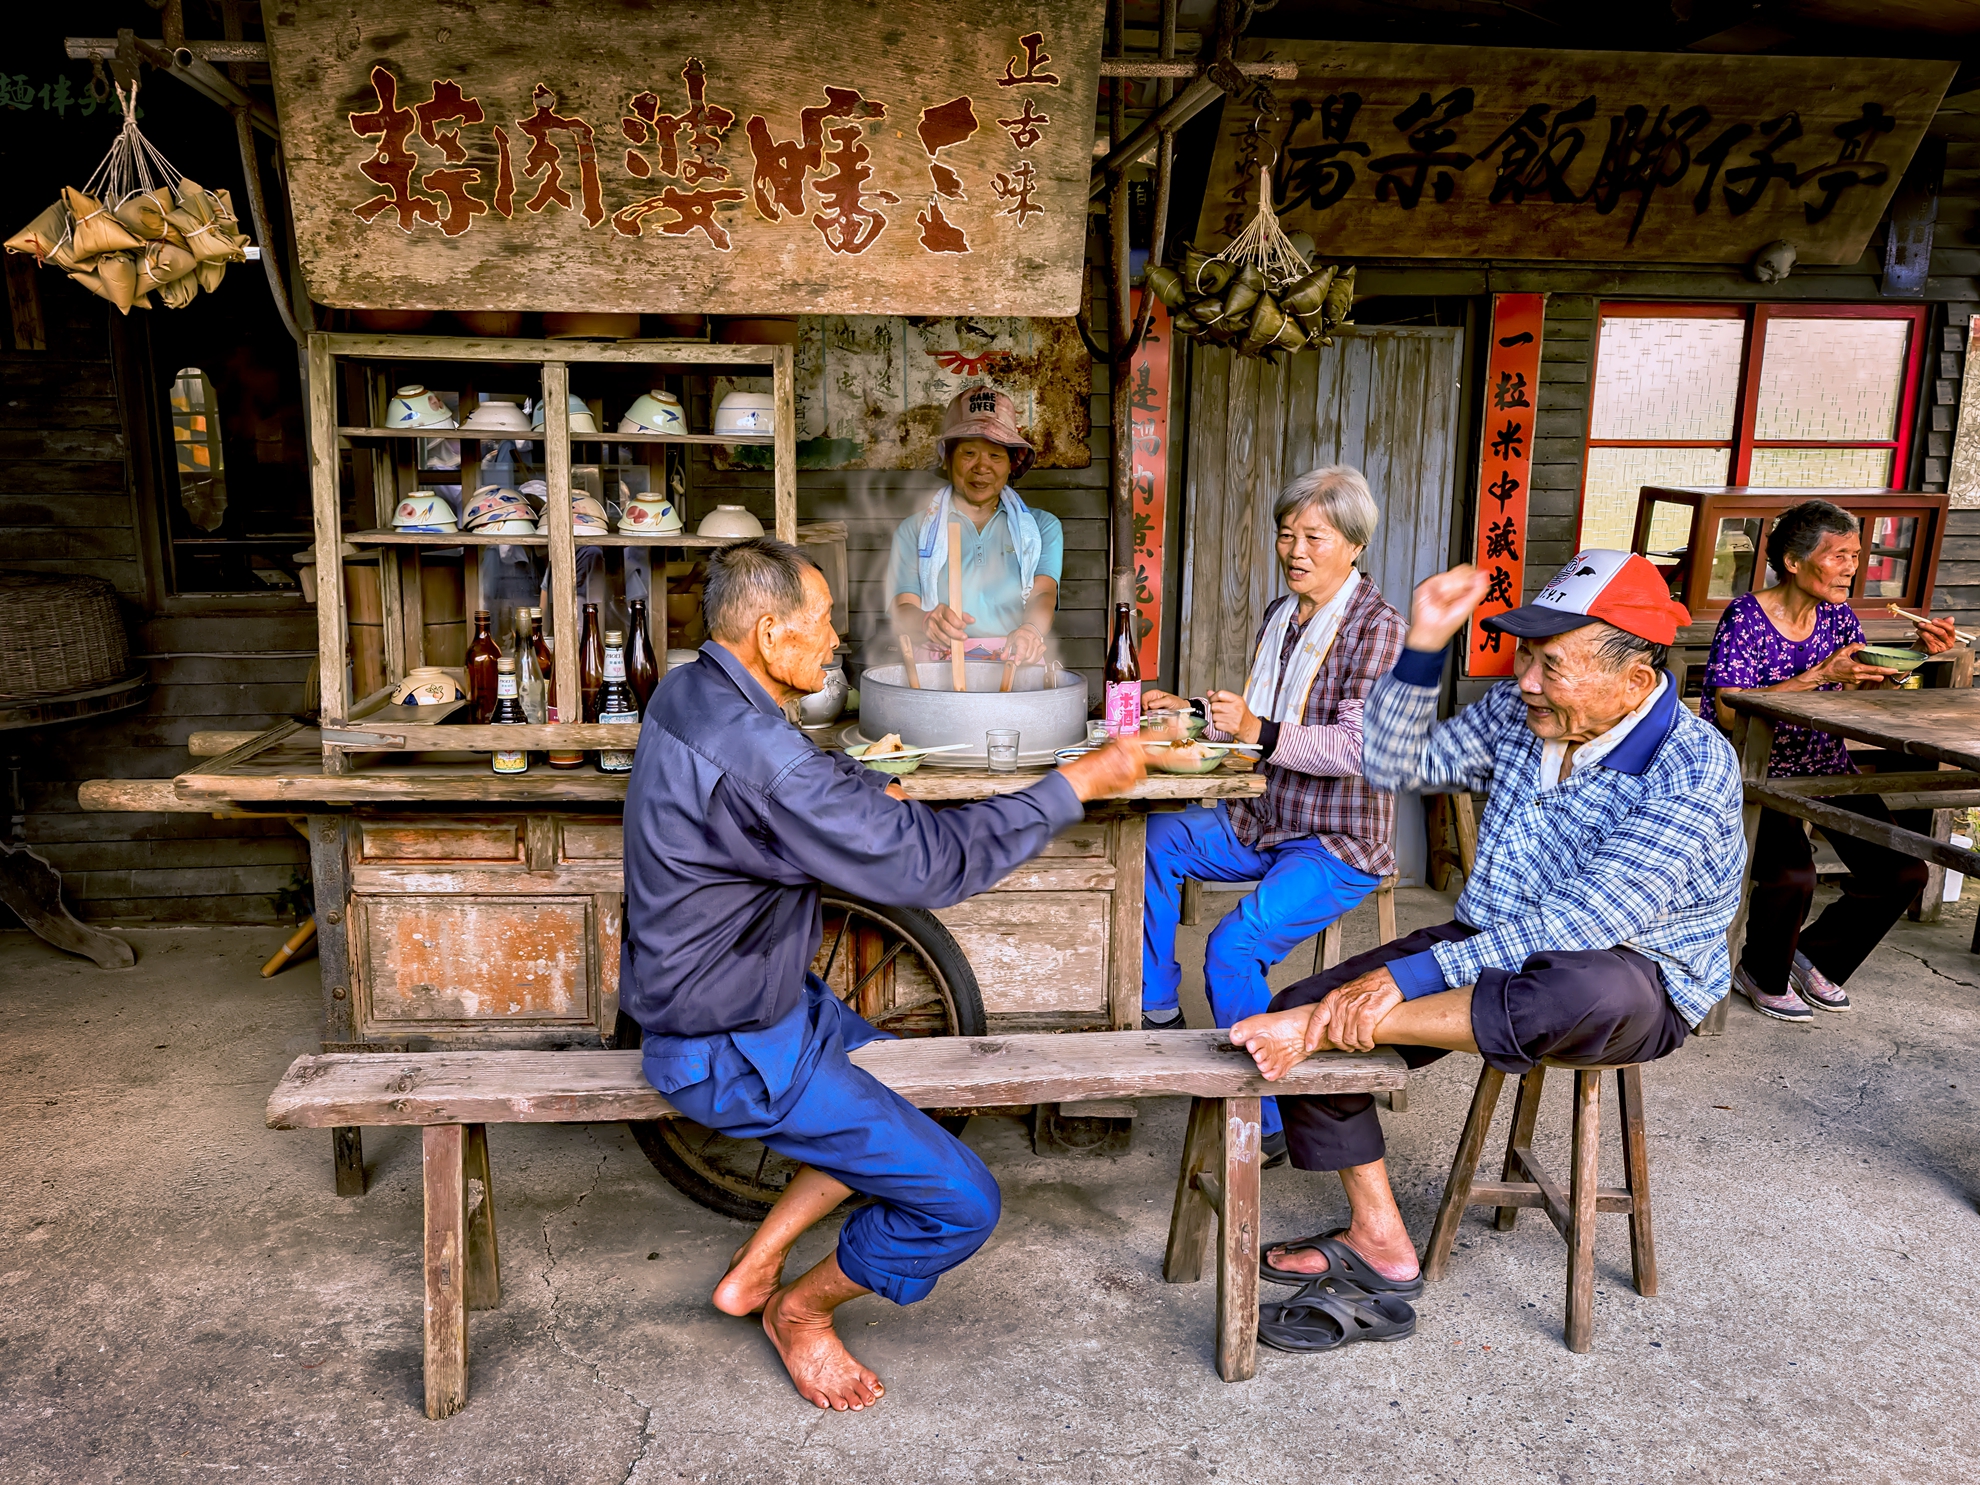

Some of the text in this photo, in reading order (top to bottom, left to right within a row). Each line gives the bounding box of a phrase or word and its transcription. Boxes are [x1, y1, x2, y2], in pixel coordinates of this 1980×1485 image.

[992, 31, 1060, 228] 正古味
[969, 392, 996, 402] GAME
[969, 402, 996, 413] OVER
